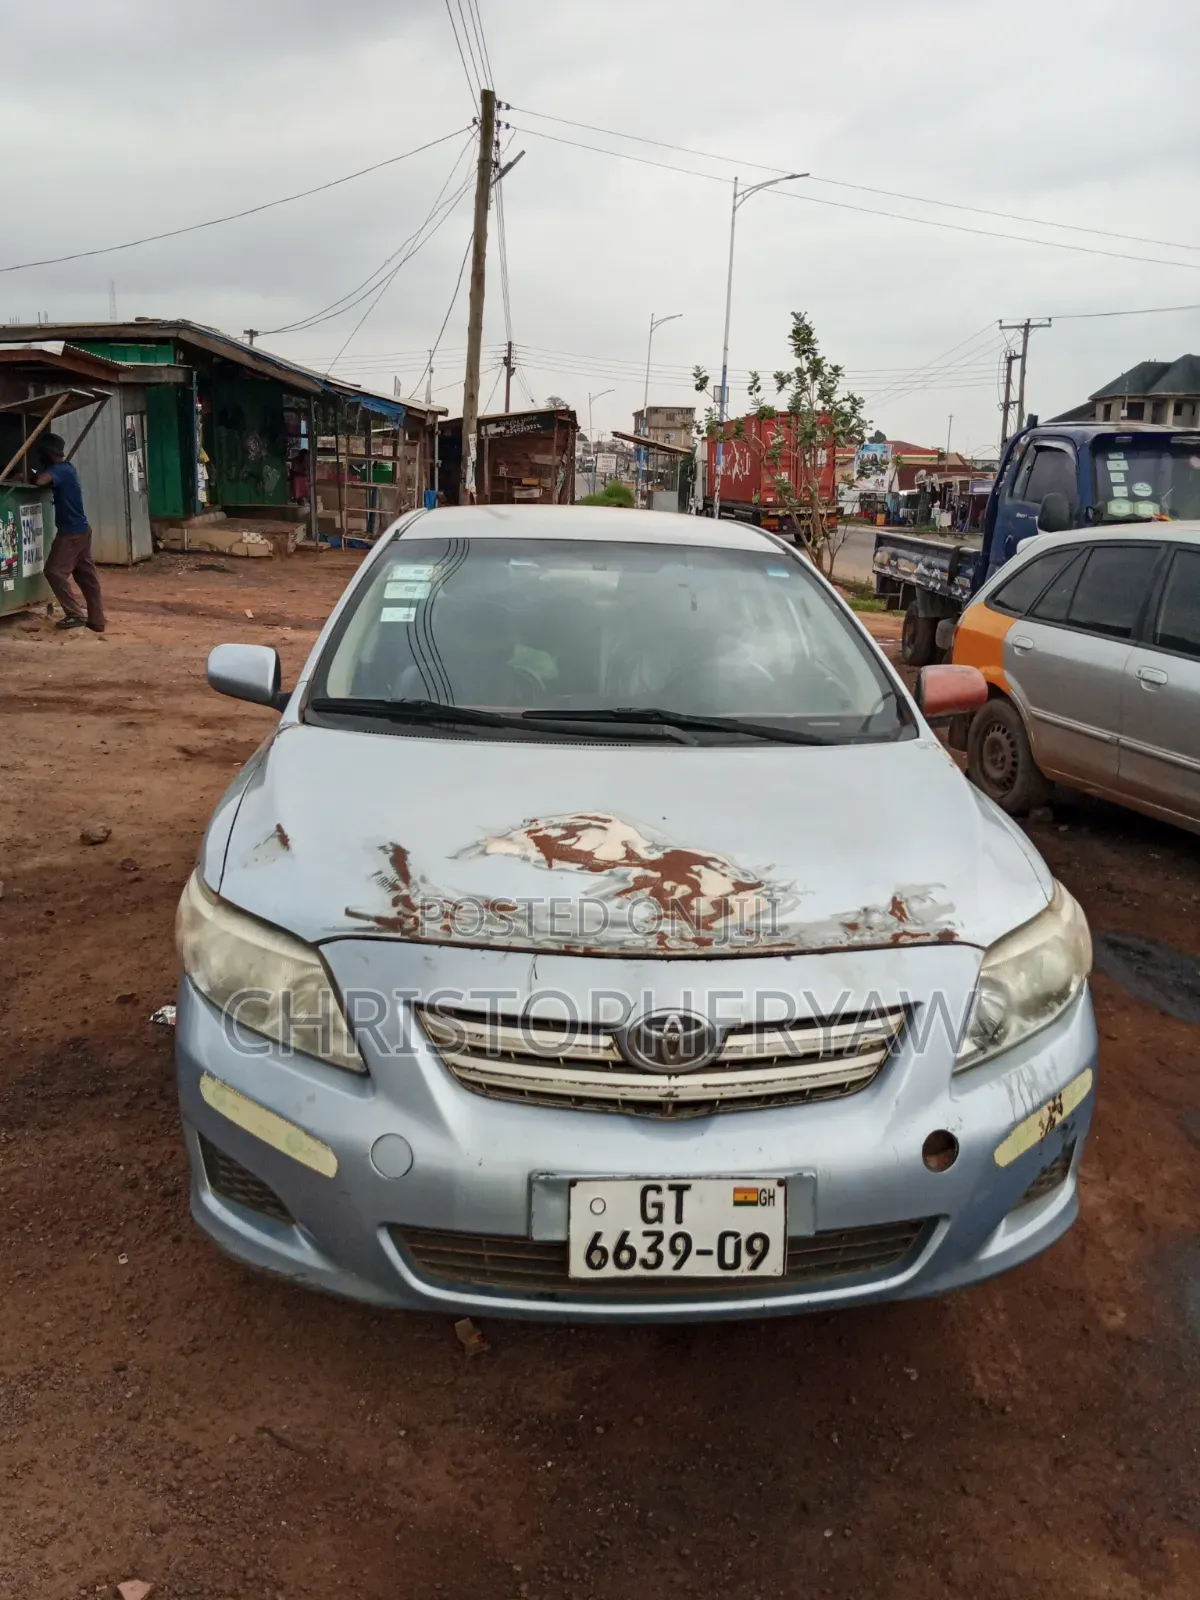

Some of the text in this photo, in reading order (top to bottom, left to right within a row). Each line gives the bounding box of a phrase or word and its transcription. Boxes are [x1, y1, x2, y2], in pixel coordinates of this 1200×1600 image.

[640, 1184, 692, 1225] GT
[759, 1188, 776, 1207] GH
[585, 1230, 770, 1271] 6639-09
